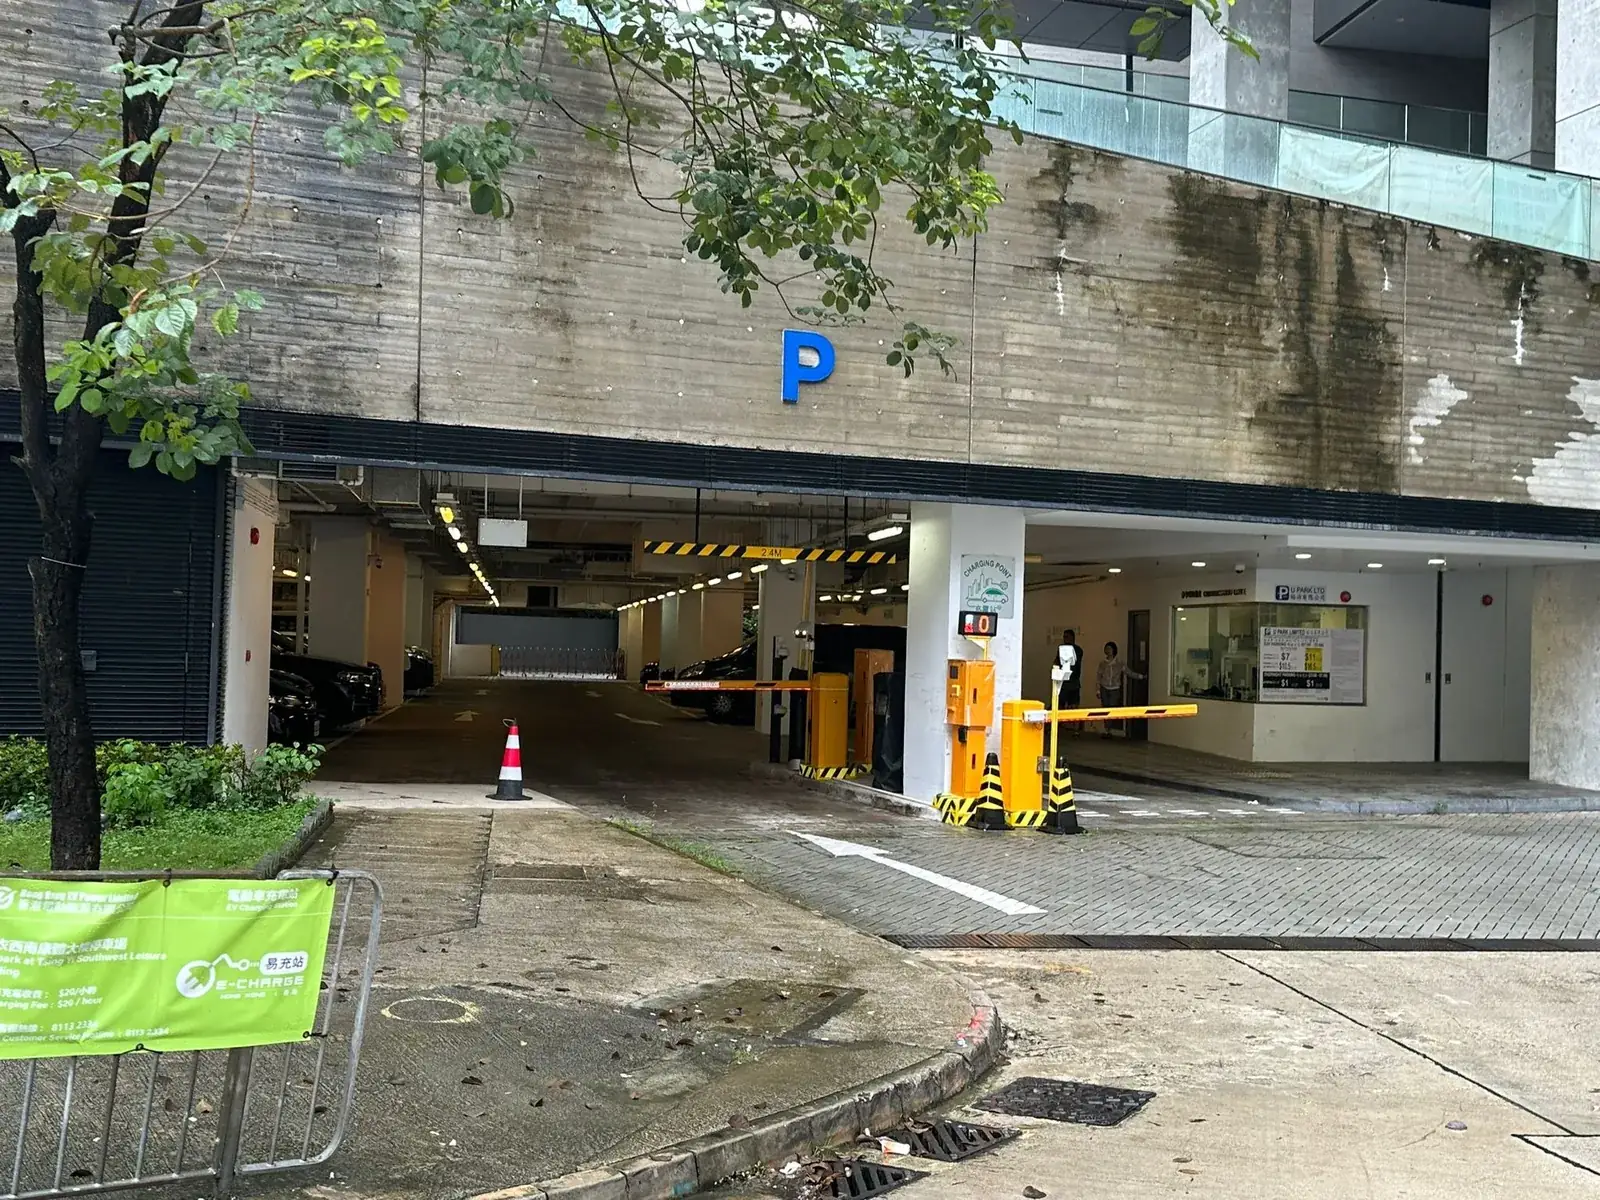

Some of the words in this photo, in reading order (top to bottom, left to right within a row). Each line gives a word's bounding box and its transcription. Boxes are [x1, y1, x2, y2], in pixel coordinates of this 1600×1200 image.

[781, 329, 835, 403] P
[761, 548, 782, 557] 2.4M
[963, 560, 994, 577] CHARGING
[995, 562, 1012, 579] POINT
[979, 615, 989, 633] 0
[1281, 652, 1290, 661] $7
[1305, 652, 1316, 661] $11
[1281, 678, 1289, 687] $1
[1306, 679, 1314, 687] $1
[38, 957, 65, 968] Tsing
[77, 952, 127, 963] Southwest
[129, 951, 168, 961] Leisure
[266, 957, 304, 970] 易充站
[215, 976, 305, 990] E-CHARGE
[57, 998, 74, 1009] $20
[82, 996, 104, 1005] hour
[51, 1023, 75, 1032] 8113
[2, 1034, 48, 1042] Customer
